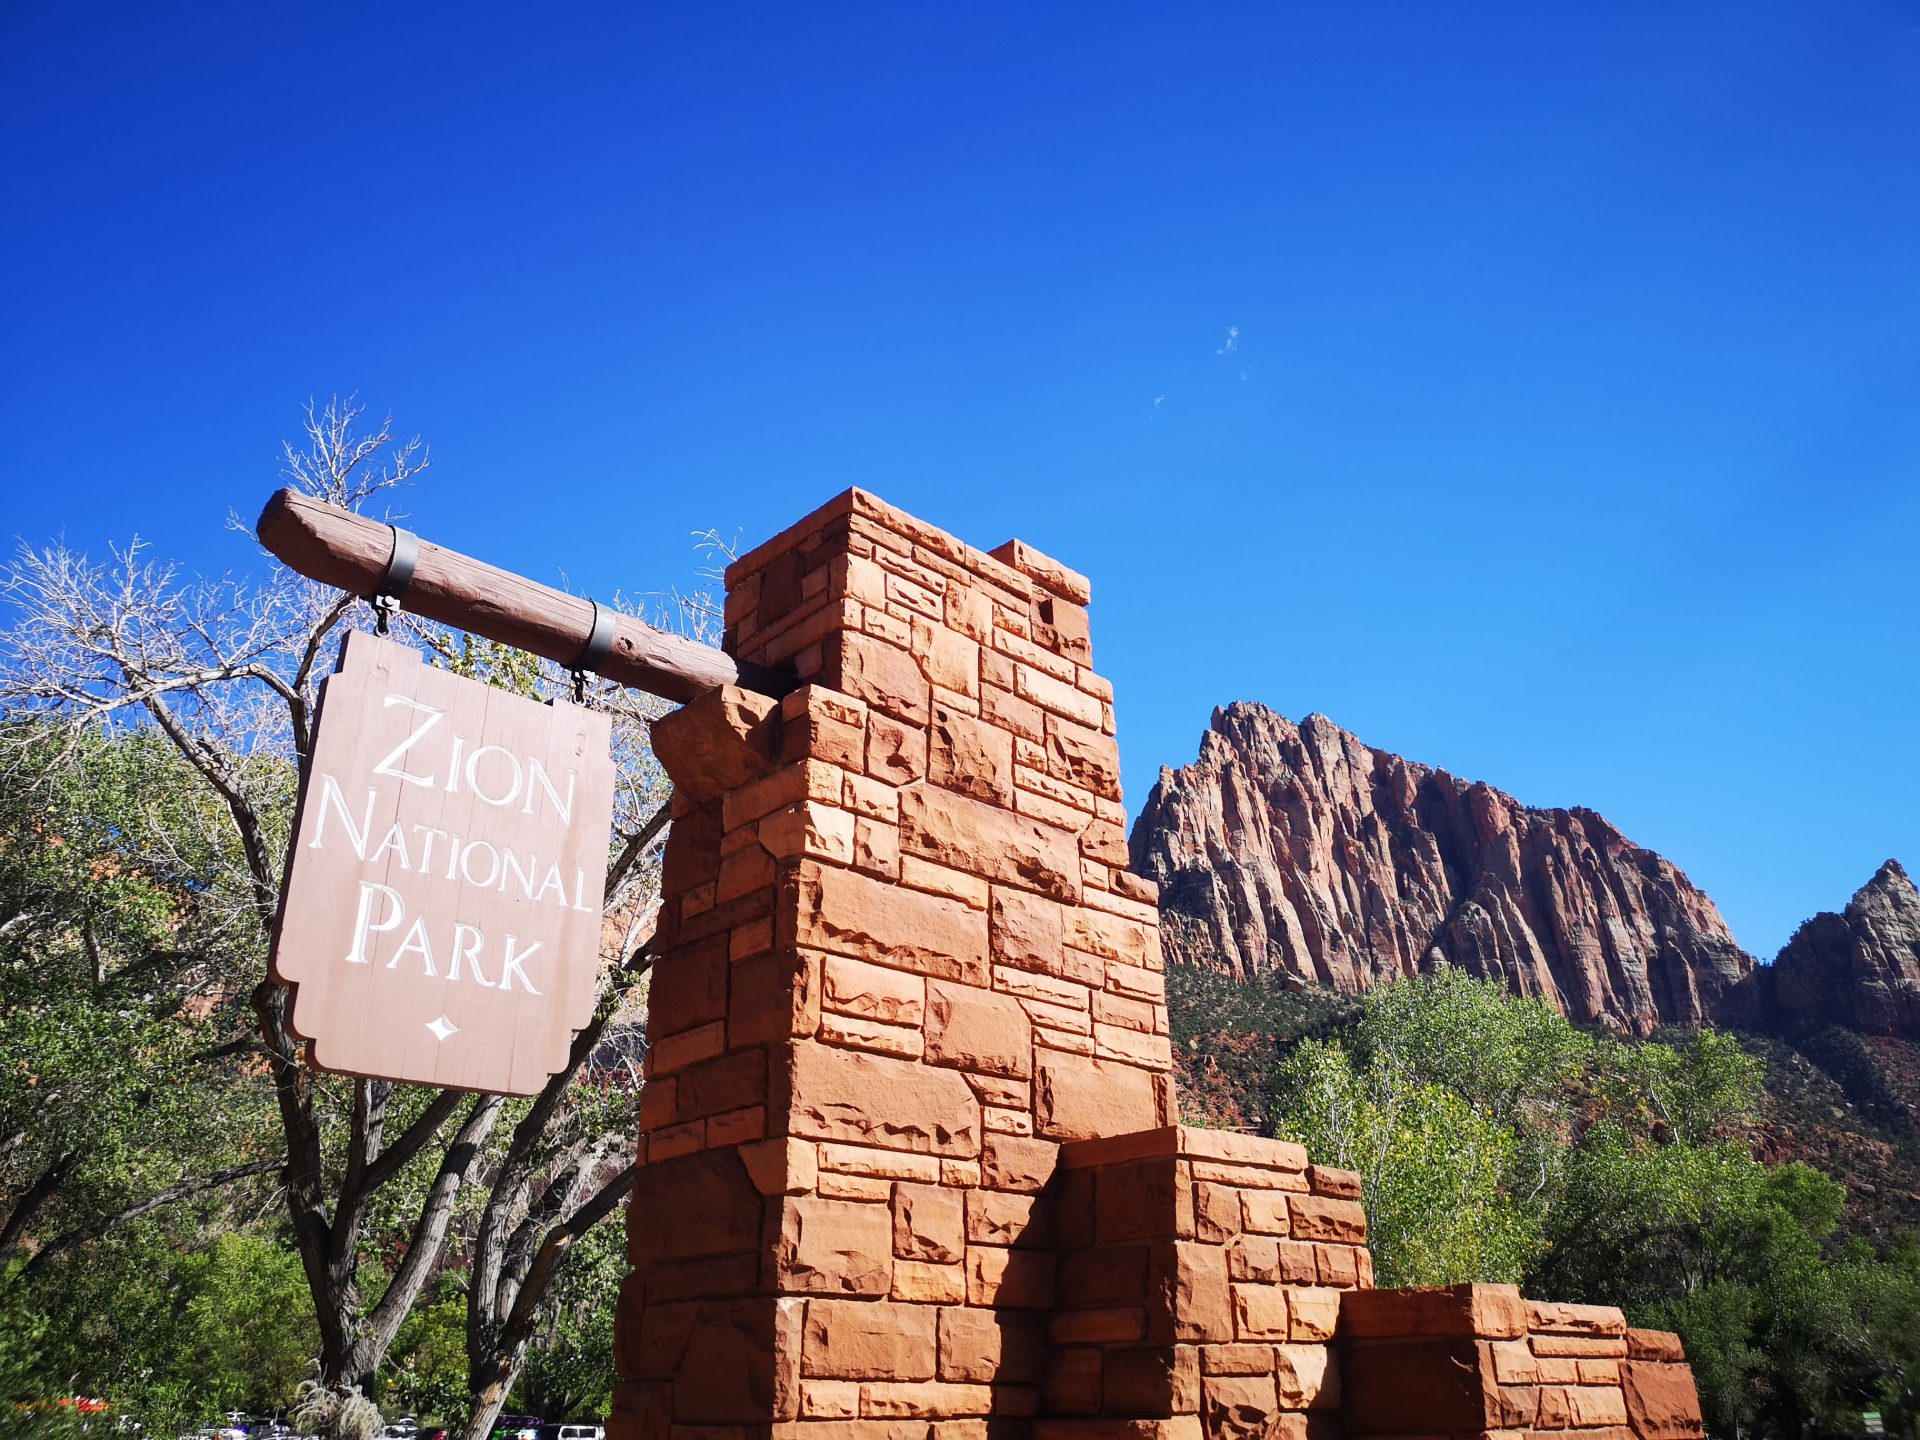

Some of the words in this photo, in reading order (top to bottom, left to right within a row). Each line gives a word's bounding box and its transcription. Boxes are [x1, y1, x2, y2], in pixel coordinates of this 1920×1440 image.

[373, 693, 577, 827] ZION
[308, 773, 594, 913] NATIONAL
[344, 880, 544, 996] PARK
